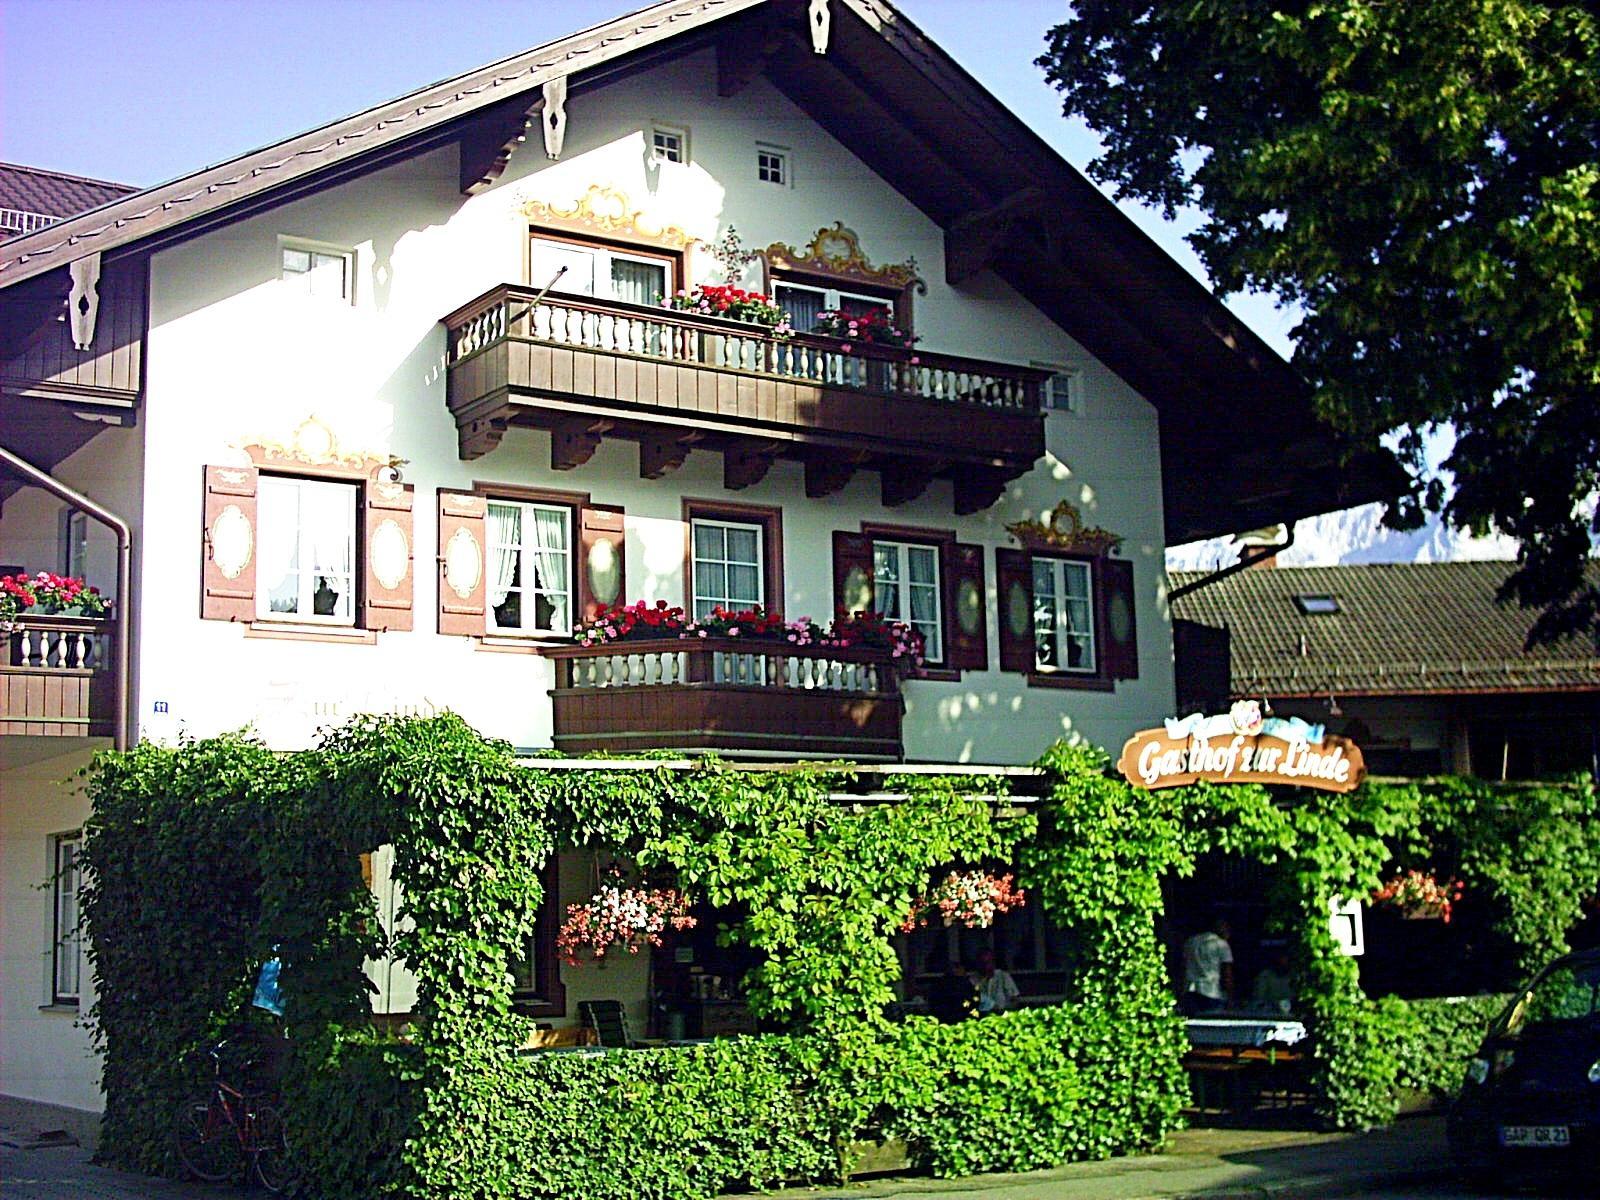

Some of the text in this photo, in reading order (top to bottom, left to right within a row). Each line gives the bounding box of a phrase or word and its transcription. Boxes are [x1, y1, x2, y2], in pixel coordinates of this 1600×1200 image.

[1138, 736, 1350, 784] Gasthof zur Linde
